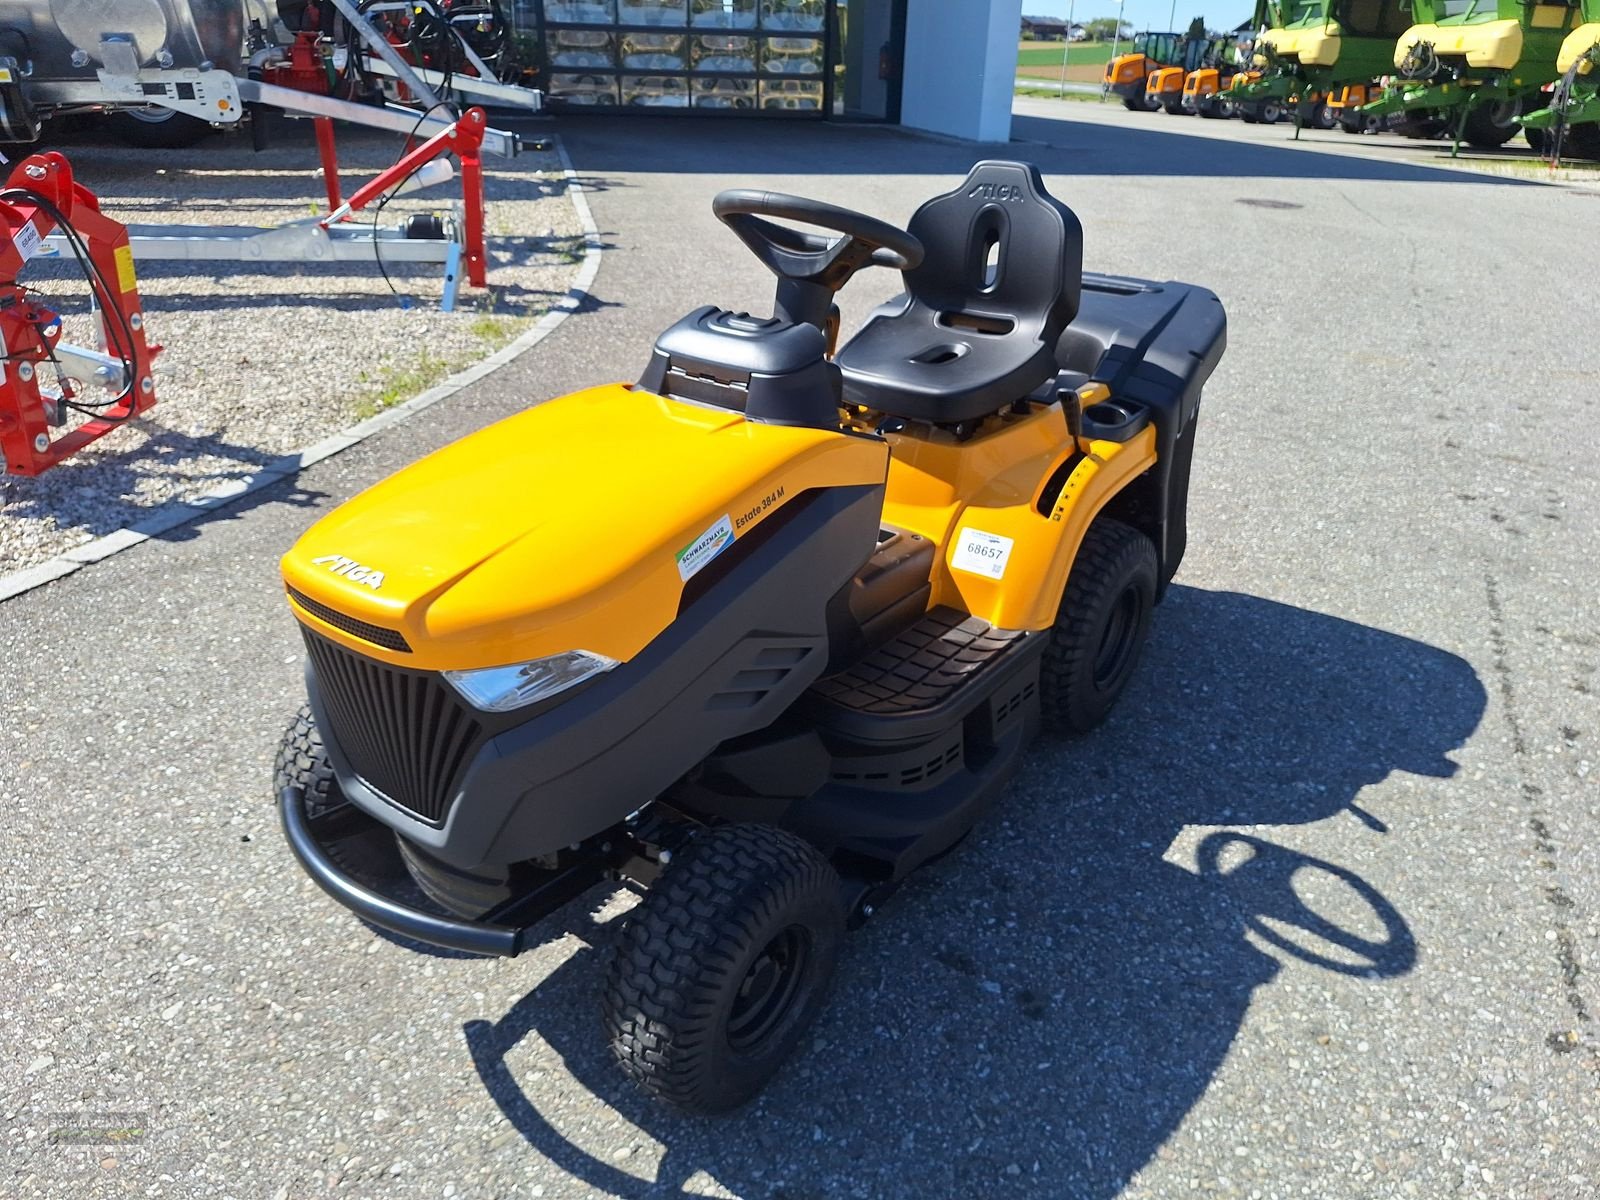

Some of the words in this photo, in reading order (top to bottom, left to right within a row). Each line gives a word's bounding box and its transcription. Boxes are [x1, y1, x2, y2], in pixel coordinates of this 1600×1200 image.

[735, 506, 762, 529] Estate
[761, 492, 777, 510] 384
[776, 485, 785, 500] M
[682, 526, 725, 564] SCHWARZMAYR
[967, 542, 1004, 560] 68657
[311, 553, 385, 591] STIGA
